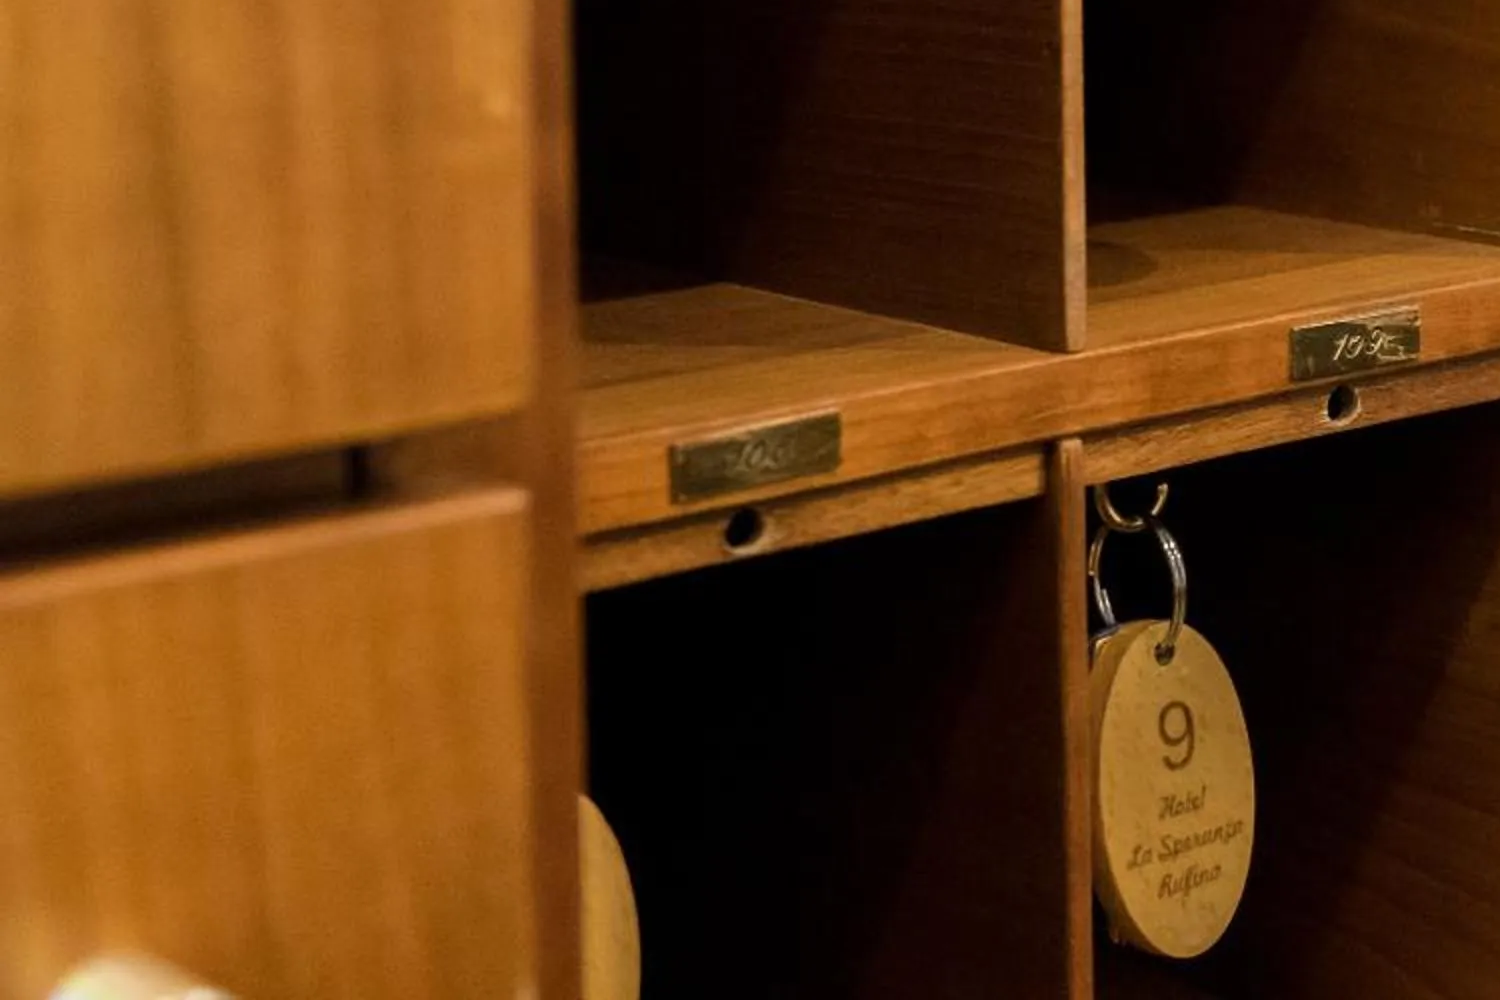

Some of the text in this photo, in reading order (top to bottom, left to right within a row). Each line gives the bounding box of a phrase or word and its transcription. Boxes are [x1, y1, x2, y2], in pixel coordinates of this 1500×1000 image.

[1157, 701, 1196, 771] 9
[1158, 785, 1206, 821] Hotel
[1126, 844, 1153, 870] La
